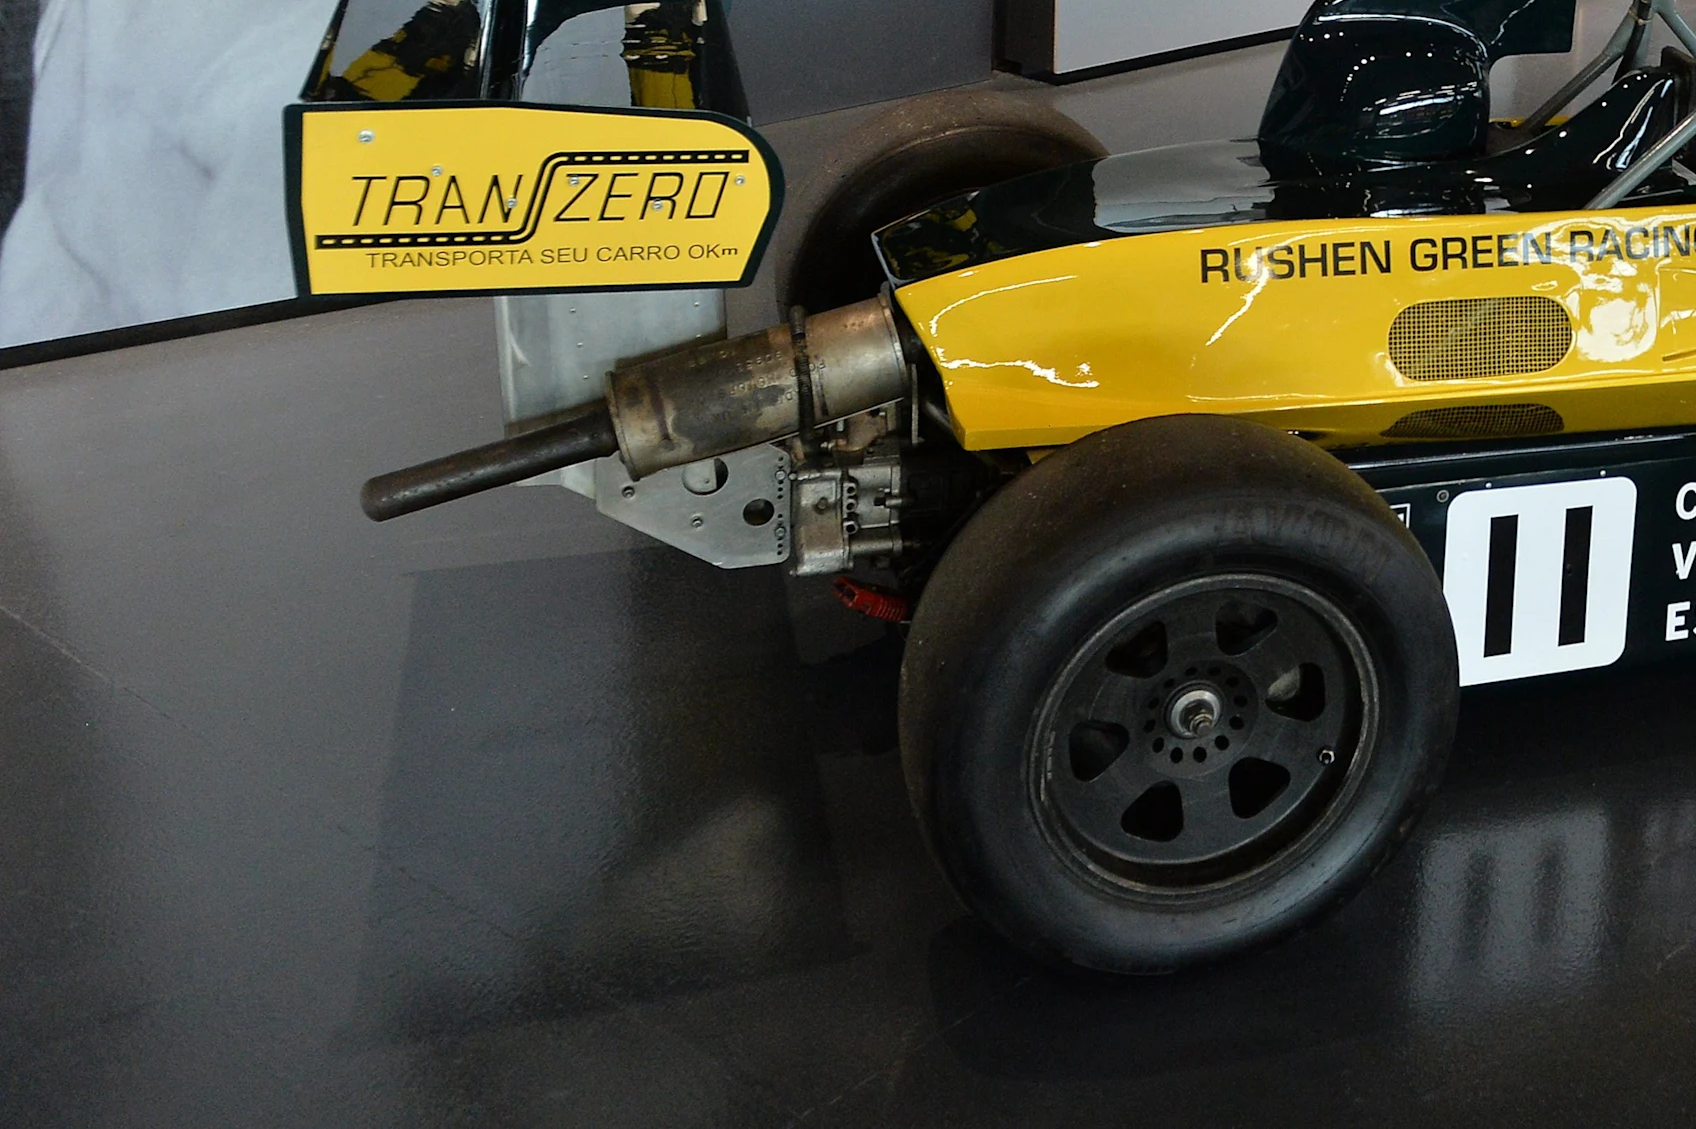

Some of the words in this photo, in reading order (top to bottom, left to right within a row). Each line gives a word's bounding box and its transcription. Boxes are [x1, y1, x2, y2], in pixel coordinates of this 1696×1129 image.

[366, 247, 534, 269] TRANSPORTA
[541, 246, 588, 265] SEU
[596, 244, 680, 262] CARRO
[1200, 237, 1392, 285] RUSHEN
[1410, 230, 1552, 273] GREEN
[1483, 505, 1594, 659] 11
